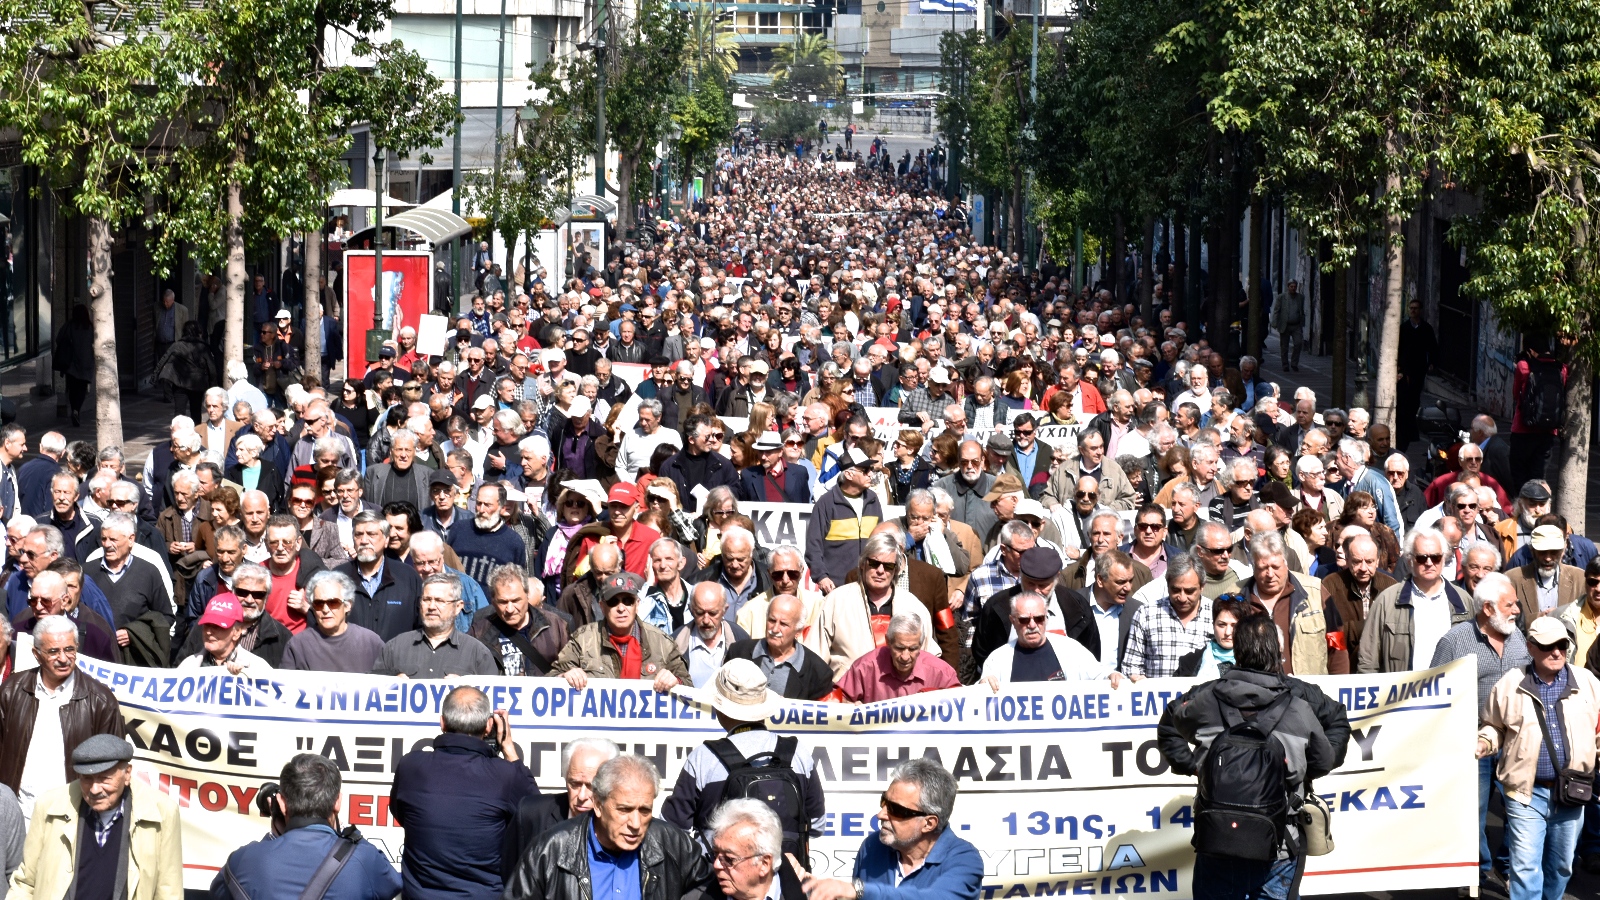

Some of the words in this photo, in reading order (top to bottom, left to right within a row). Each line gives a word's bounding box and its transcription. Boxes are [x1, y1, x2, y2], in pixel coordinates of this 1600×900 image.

[751, 510, 812, 545] ΚΑΤ
[531, 686, 701, 720] ΟΡΓΑΝΩΣΕΙΣ:
[849, 697, 966, 725] ΔΗΜΟΣΙΟΥ
[986, 695, 1045, 722] ΠΟΣΕ
[1051, 693, 1110, 721] ΟΑΕΕ
[1131, 691, 1183, 717] ΕΛΤ
[121, 715, 258, 768] ΚΑΘΕ
[1101, 740, 1171, 777] ΤΟ
[1002, 811, 1116, 840] 13ης,
[1145, 805, 1194, 830] 14
